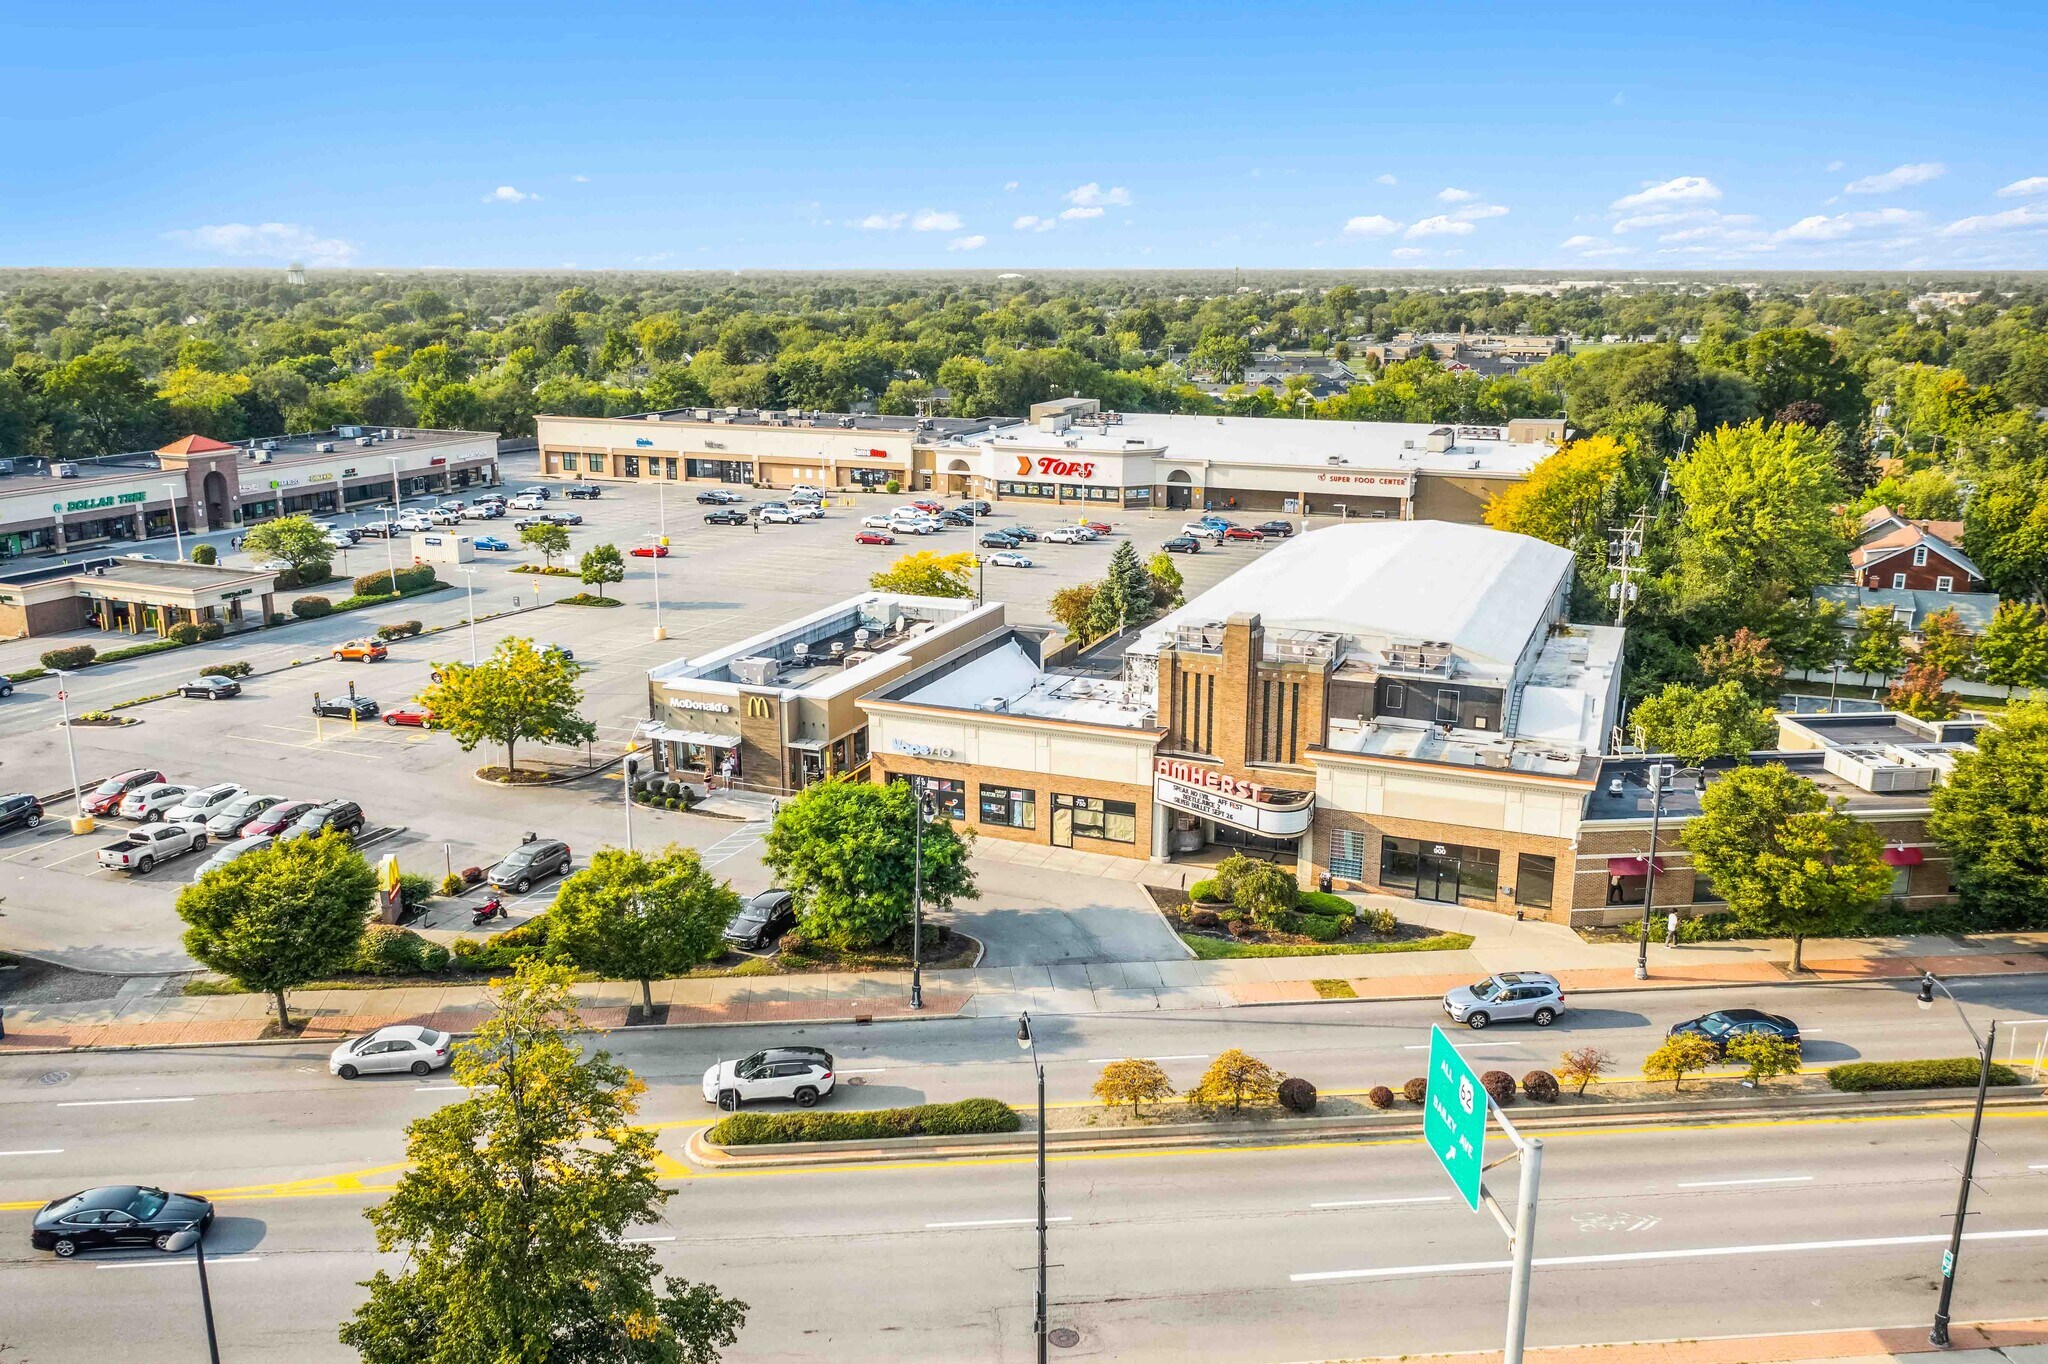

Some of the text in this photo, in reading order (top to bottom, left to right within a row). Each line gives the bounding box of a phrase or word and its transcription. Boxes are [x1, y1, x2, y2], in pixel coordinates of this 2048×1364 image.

[1037, 456, 1095, 479] TOPS
[1329, 475, 1350, 483] SUPER
[1378, 478, 1405, 486] CENTER
[67, 491, 146, 512] DOLLAR TREE
[669, 697, 730, 714] McDonald's
[1157, 758, 1265, 803] AMHERST
[1172, 784, 1243, 811] SPEAK NO EVIL AFF FEST
[1173, 796, 1190, 807] SILVER
[1191, 802, 1211, 813] BULLET
[1211, 808, 1225, 818] SEPT
[1182, 793, 1216, 809] BEETLEJUICE
[1440, 1059, 1454, 1085] ALL
[1460, 1084, 1472, 1110] 62
[1432, 1094, 1458, 1135] BAILEY
